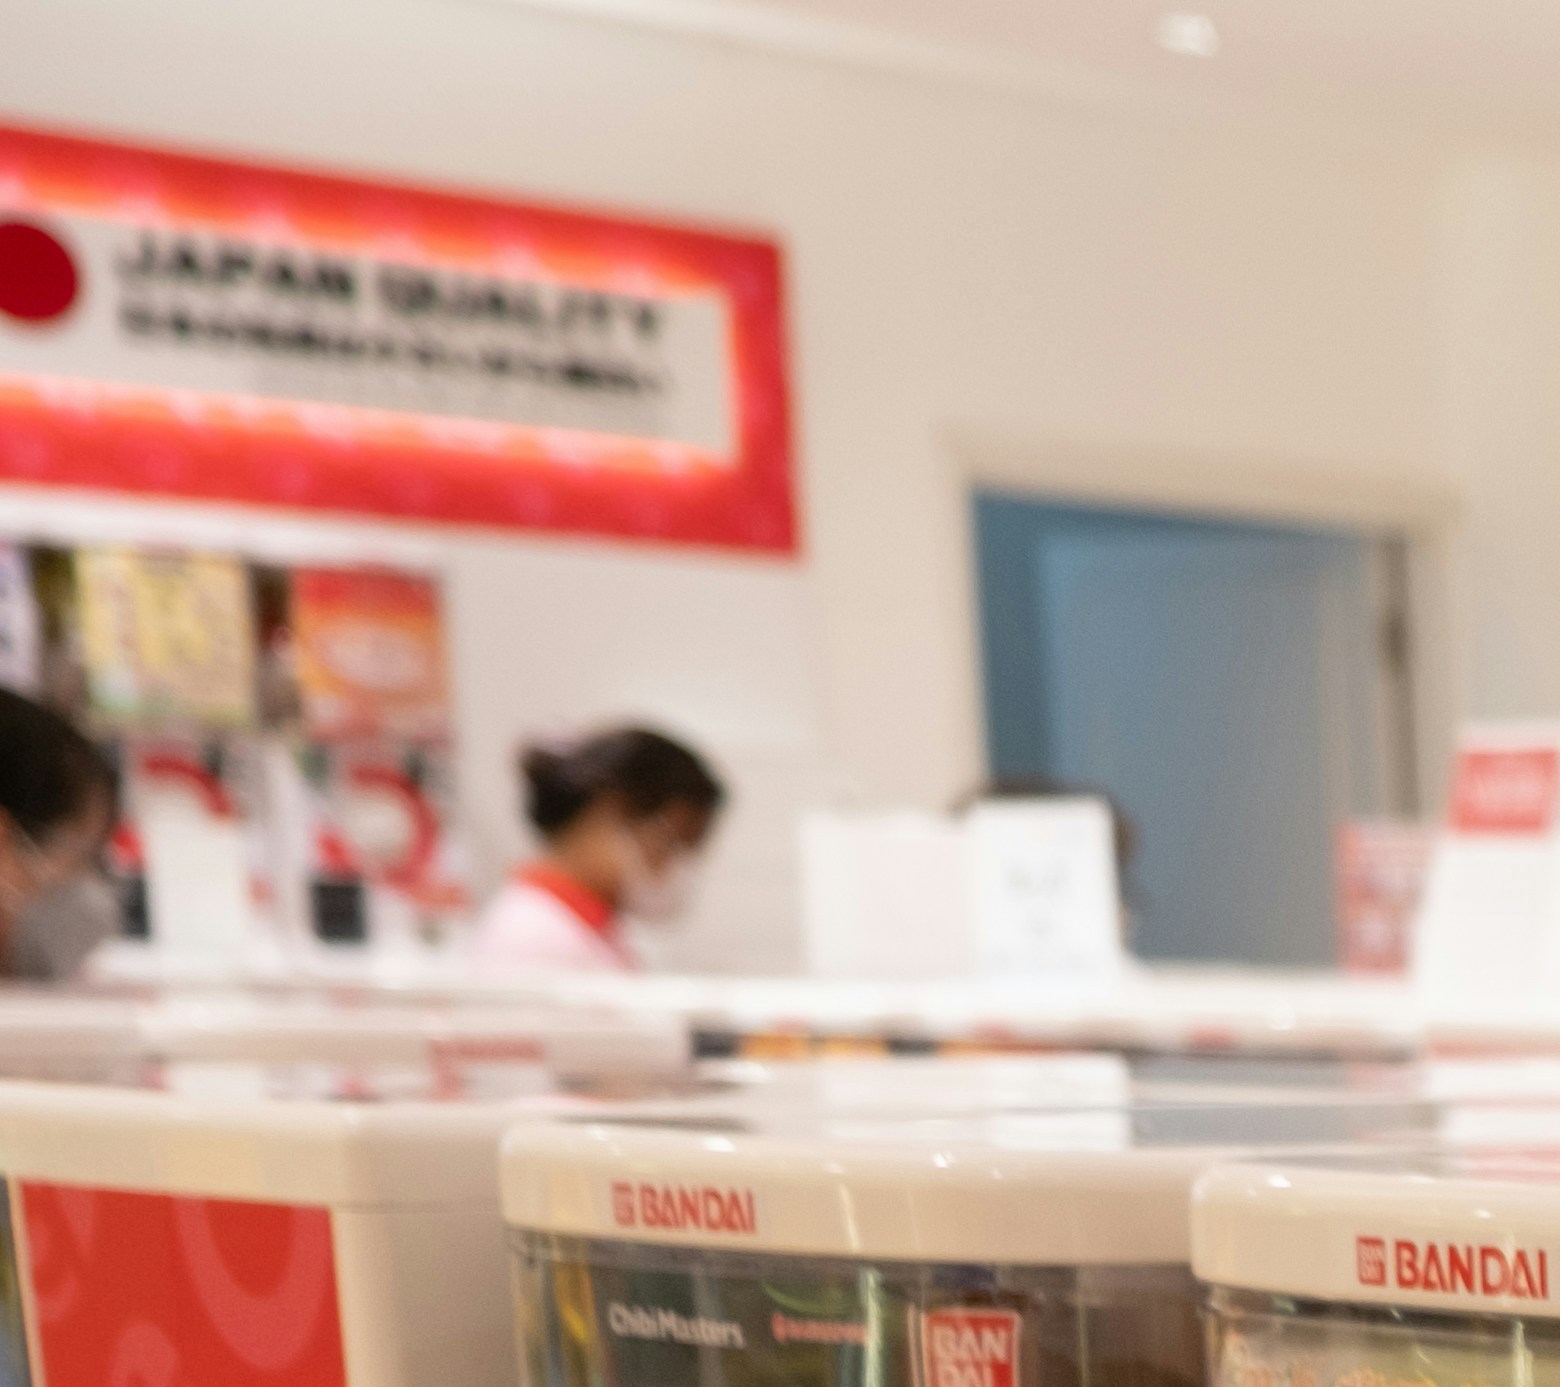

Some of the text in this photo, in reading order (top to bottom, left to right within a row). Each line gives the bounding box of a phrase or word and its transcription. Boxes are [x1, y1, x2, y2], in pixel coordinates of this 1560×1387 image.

[116, 230, 666, 341] JAPAN QUALITY
[639, 1181, 757, 1236] BANDAI
[1394, 1240, 1550, 1301] BANDAI
